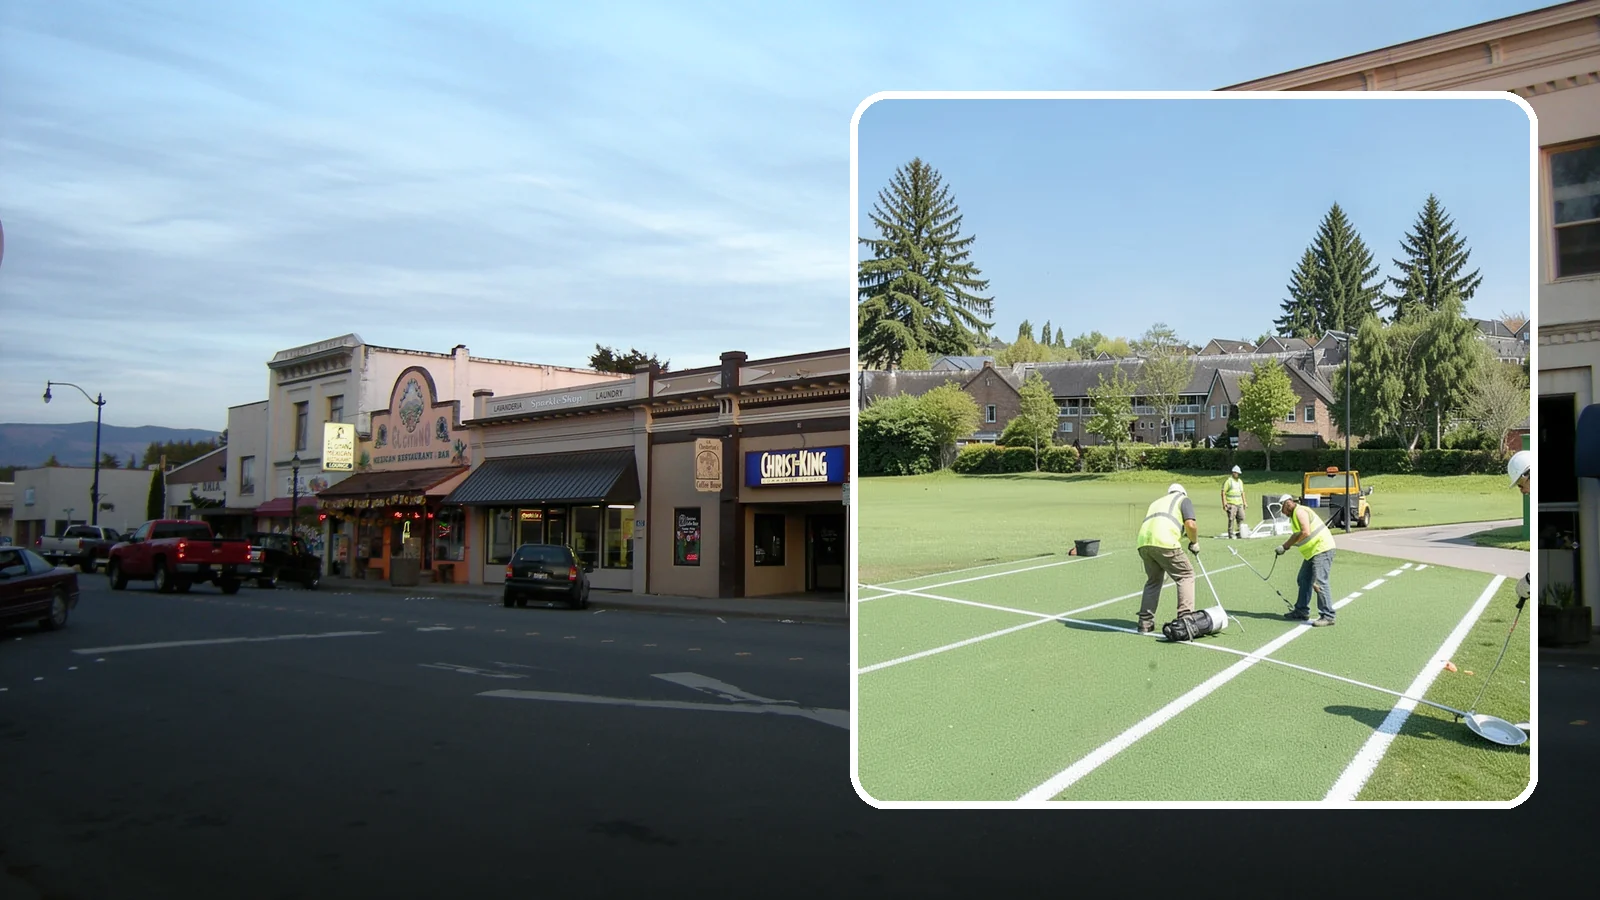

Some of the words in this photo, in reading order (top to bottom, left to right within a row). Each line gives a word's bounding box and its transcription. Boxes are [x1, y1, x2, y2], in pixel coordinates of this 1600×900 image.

[596, 389, 623, 400] LAUNDRY
[494, 402, 522, 412] LAVANDERIA
[531, 396, 560, 408] Sparkle
[562, 394, 582, 405] Shop
[327, 450, 352, 458] MEXICAN
[373, 454, 396, 464] MEXICAN
[397, 451, 434, 462] RESTAURANT
[438, 450, 450, 459] BAR
[761, 452, 797, 478] CHRIST
[799, 450, 828, 476] KING
